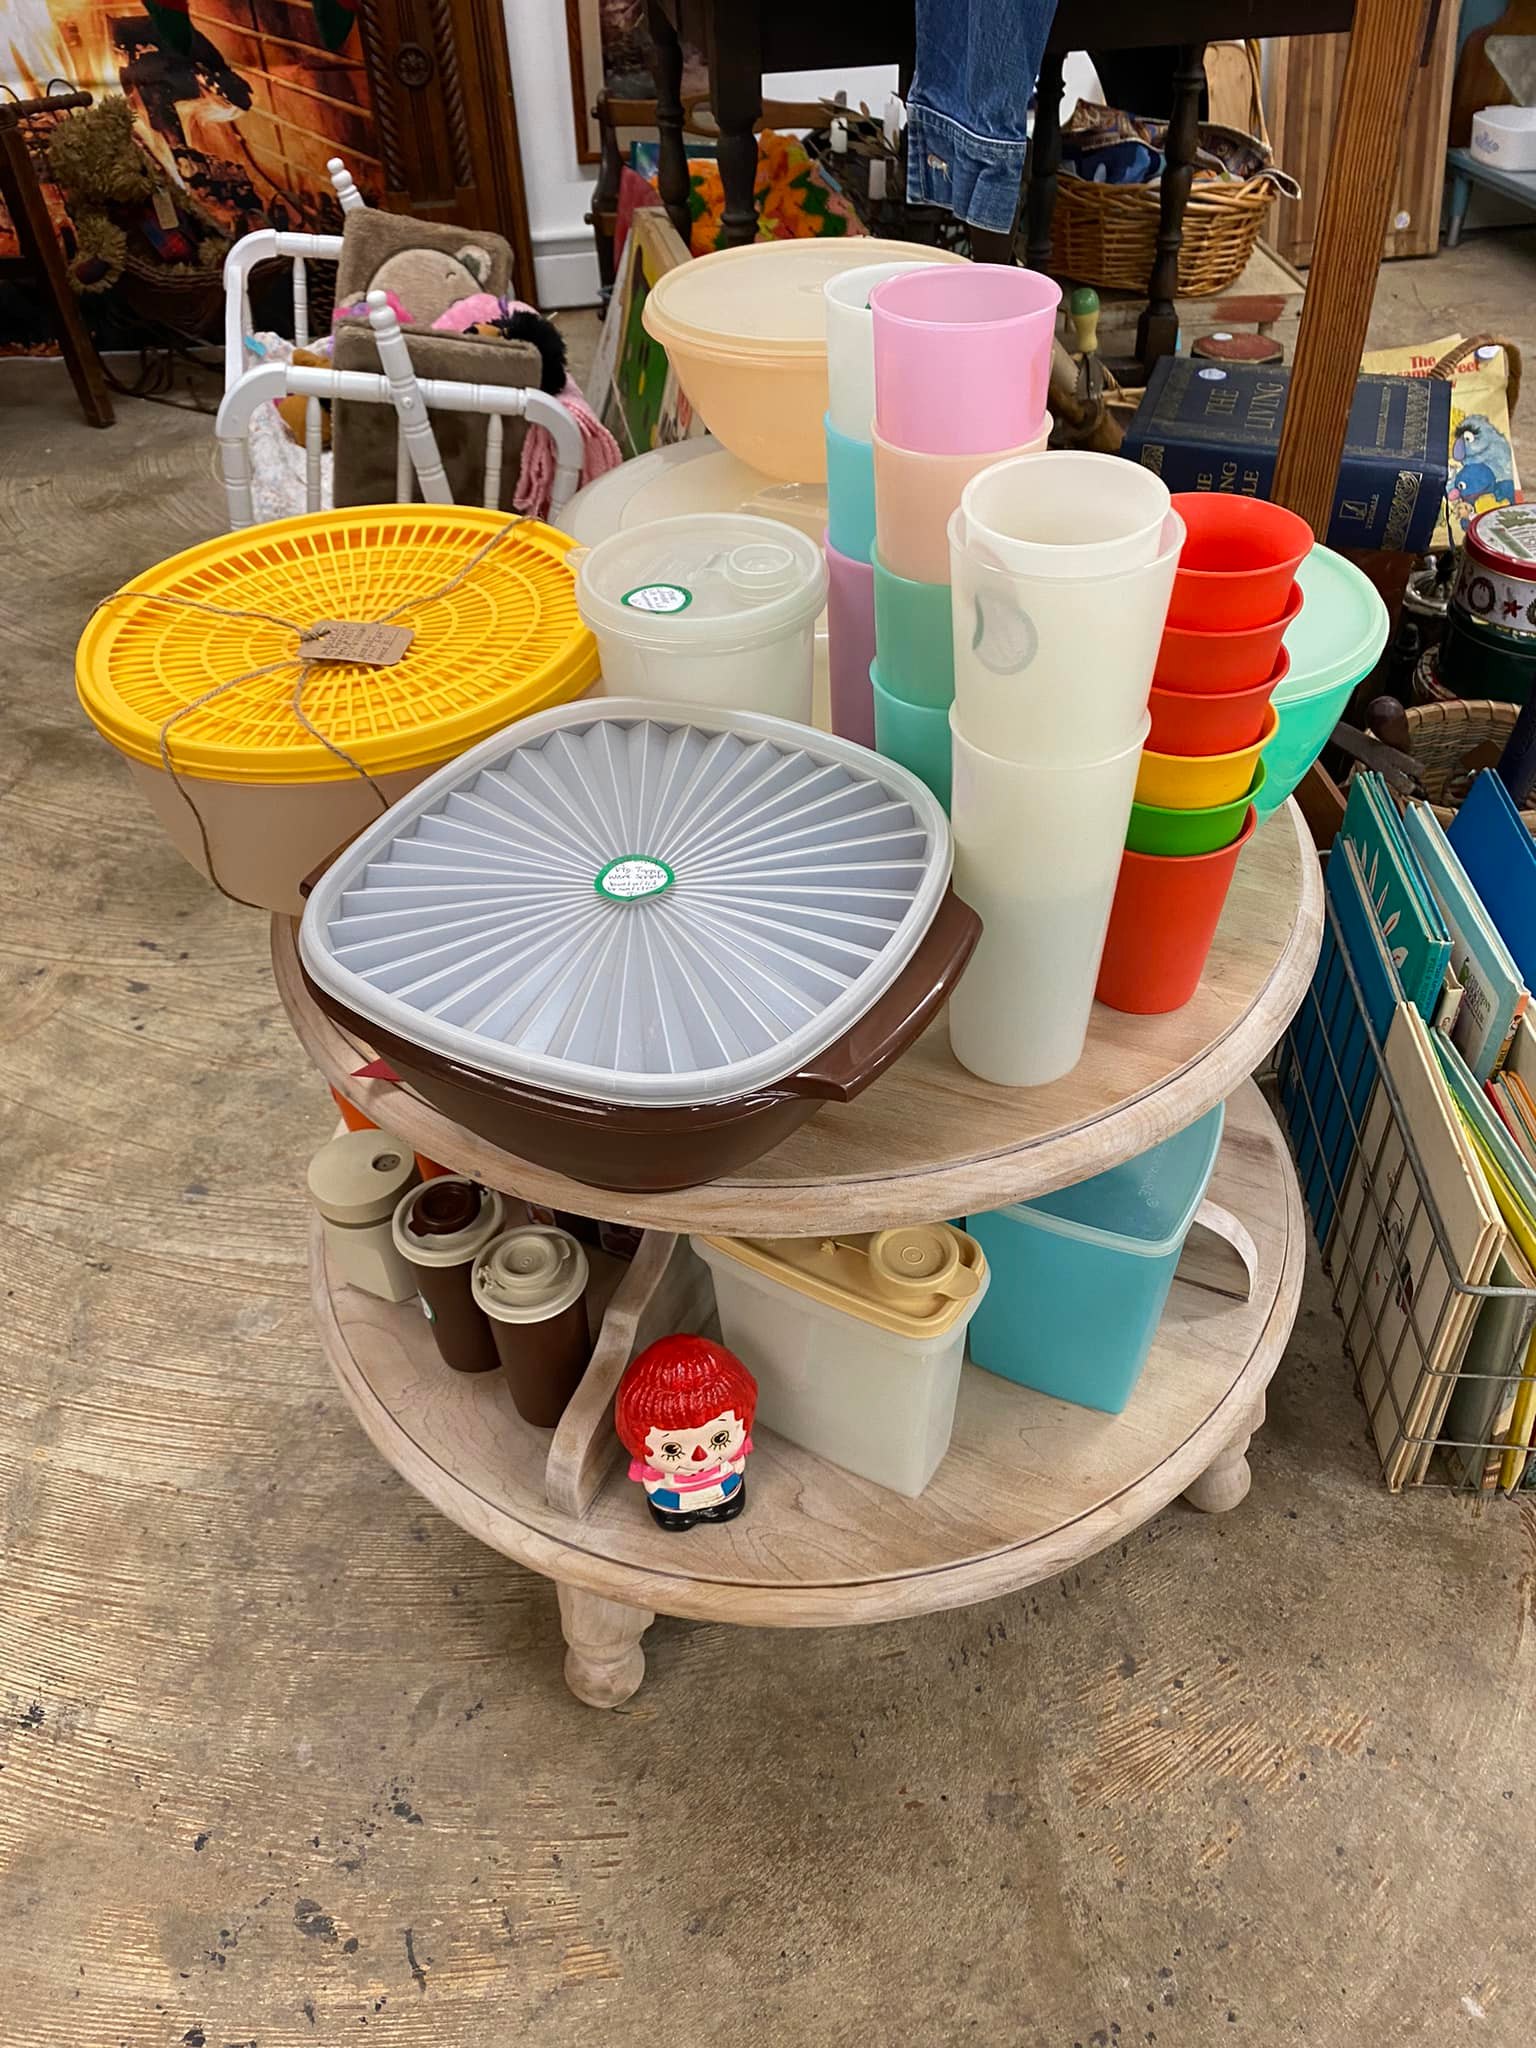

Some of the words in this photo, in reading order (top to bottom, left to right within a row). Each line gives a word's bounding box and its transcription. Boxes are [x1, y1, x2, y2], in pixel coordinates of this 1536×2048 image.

[1410, 355, 1436, 369] The
[1204, 387, 1239, 416] THE
[1244, 381, 1284, 430] LIVING
